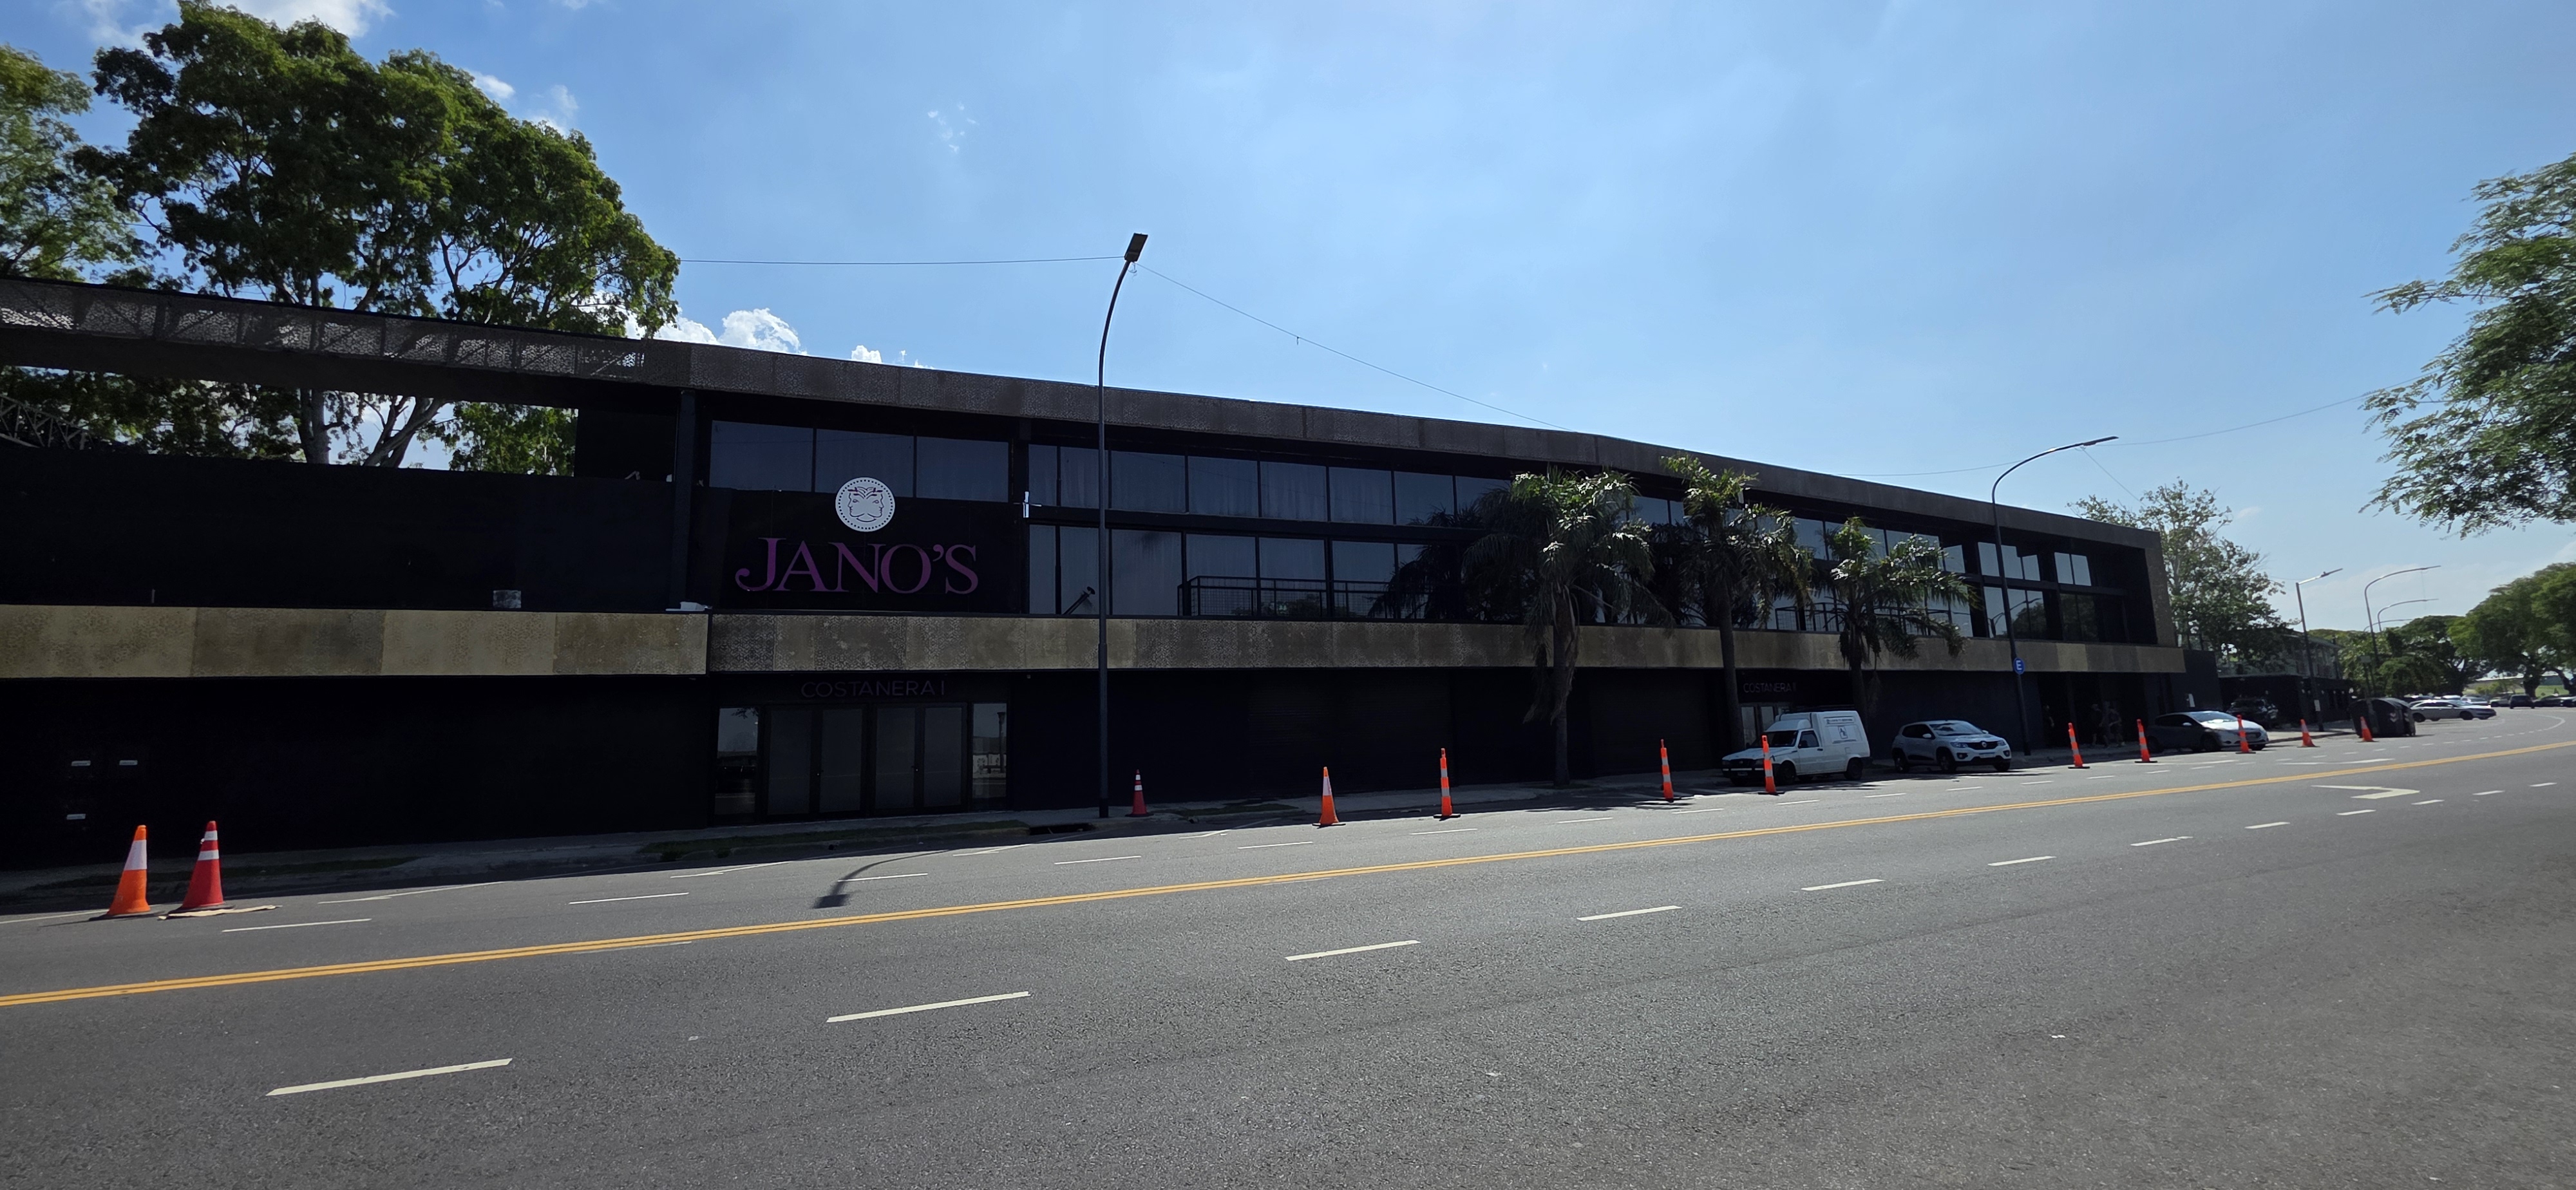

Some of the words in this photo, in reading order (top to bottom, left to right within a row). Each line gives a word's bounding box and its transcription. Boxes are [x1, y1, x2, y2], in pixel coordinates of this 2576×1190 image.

[735, 536, 979, 595] JANO'S
[2016, 660, 2023, 670] E
[800, 680, 936, 698] COSTANERA
[940, 680, 945, 695] I
[1743, 682, 1792, 693] COSTANERA
